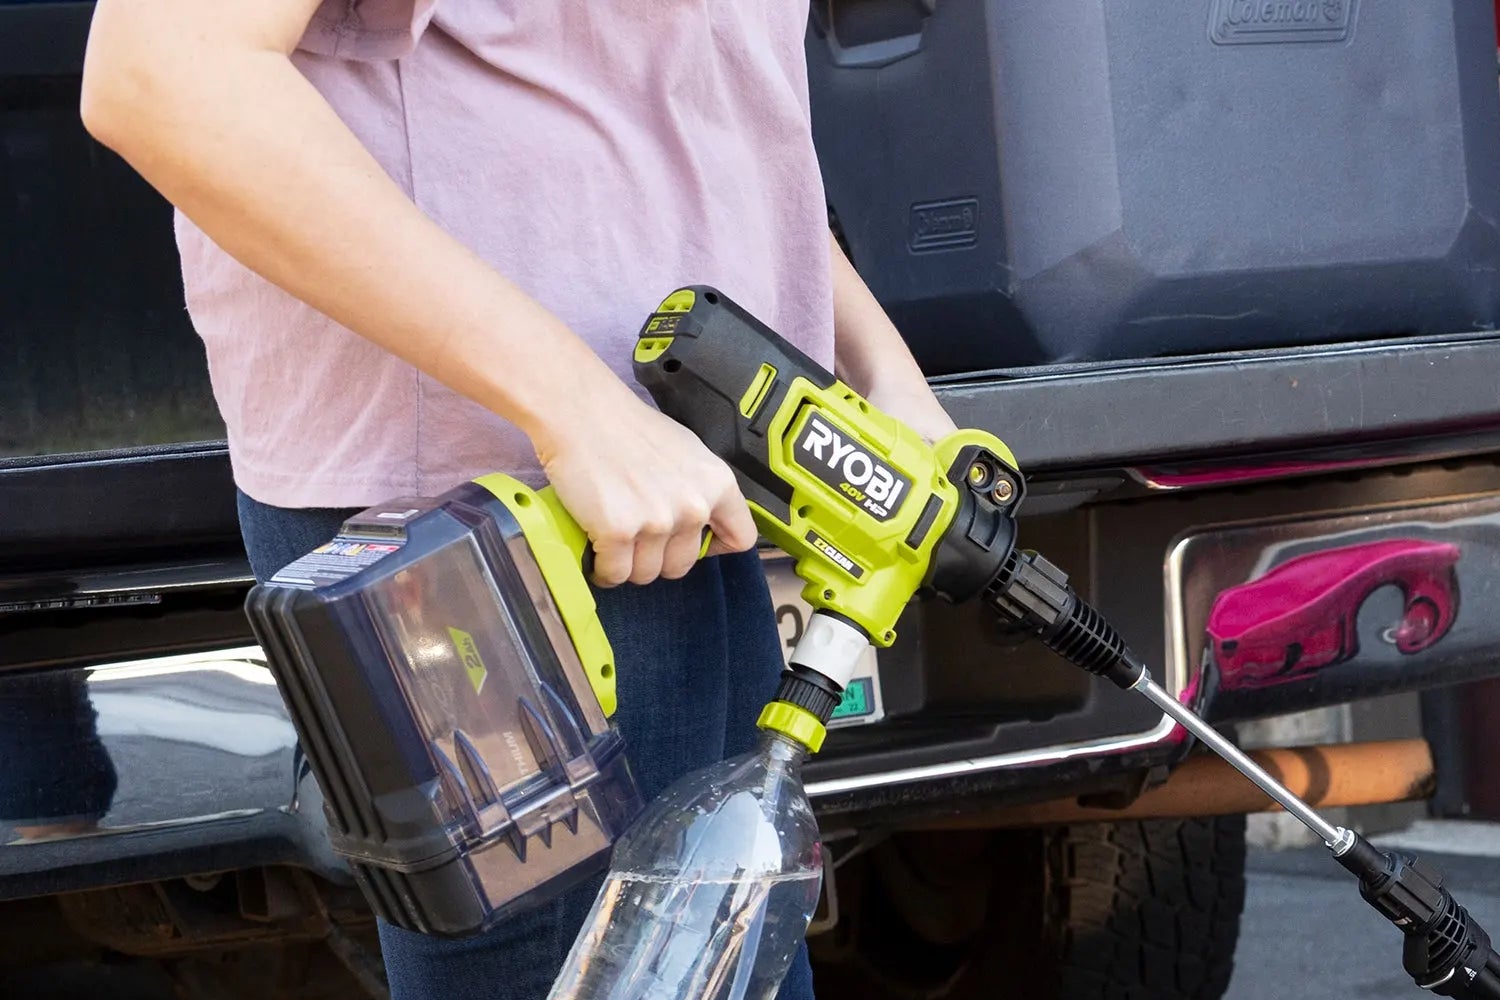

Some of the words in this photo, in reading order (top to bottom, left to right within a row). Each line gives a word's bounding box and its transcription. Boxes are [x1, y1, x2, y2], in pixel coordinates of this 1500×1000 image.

[802, 418, 904, 510] RYOBI
[839, 482, 867, 502] 40V
[864, 499, 888, 518] HP
